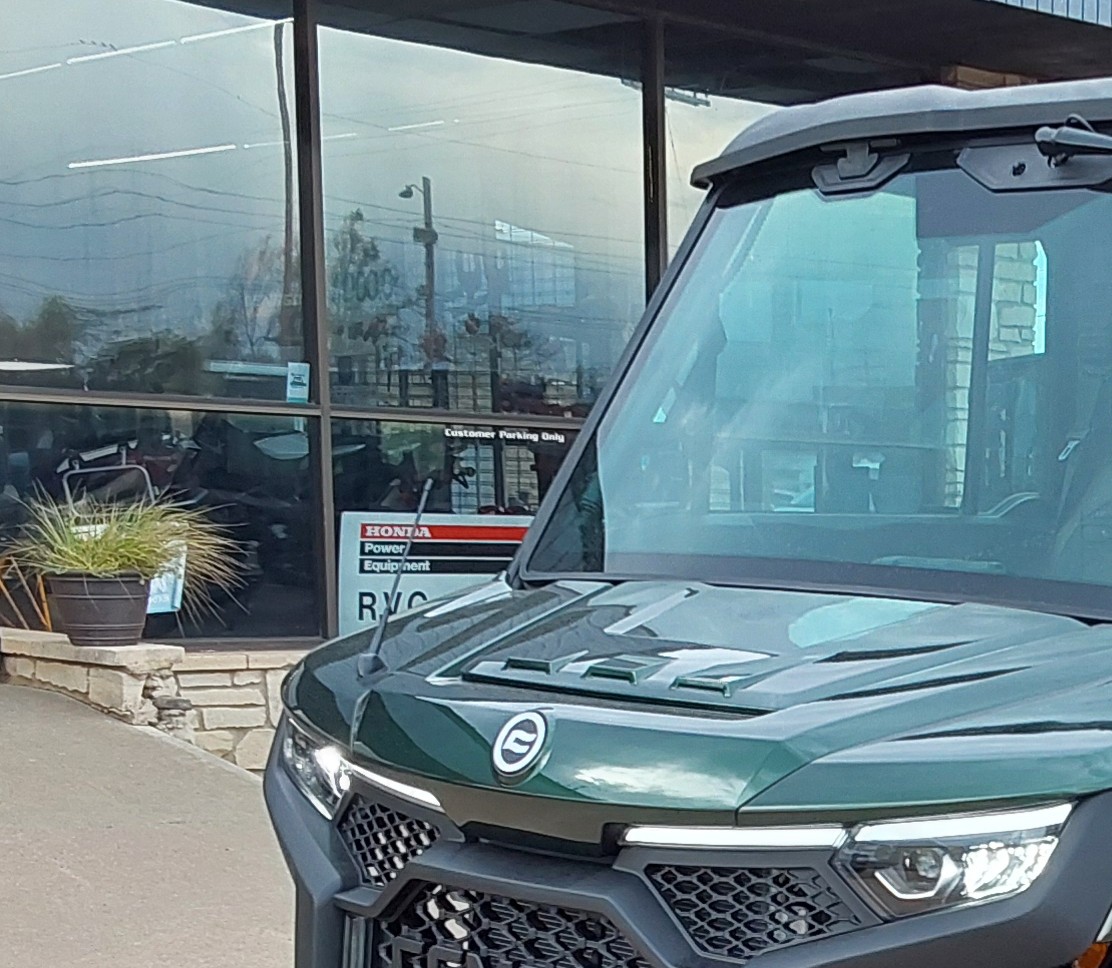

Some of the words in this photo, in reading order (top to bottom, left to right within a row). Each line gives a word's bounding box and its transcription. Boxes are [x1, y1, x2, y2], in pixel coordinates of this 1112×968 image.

[445, 428, 496, 439] Customer
[499, 430, 539, 442] Parking
[541, 431, 565, 443] Only
[365, 525, 431, 538] HONDA
[364, 543, 405, 554] Power
[364, 559, 430, 573] Equipment
